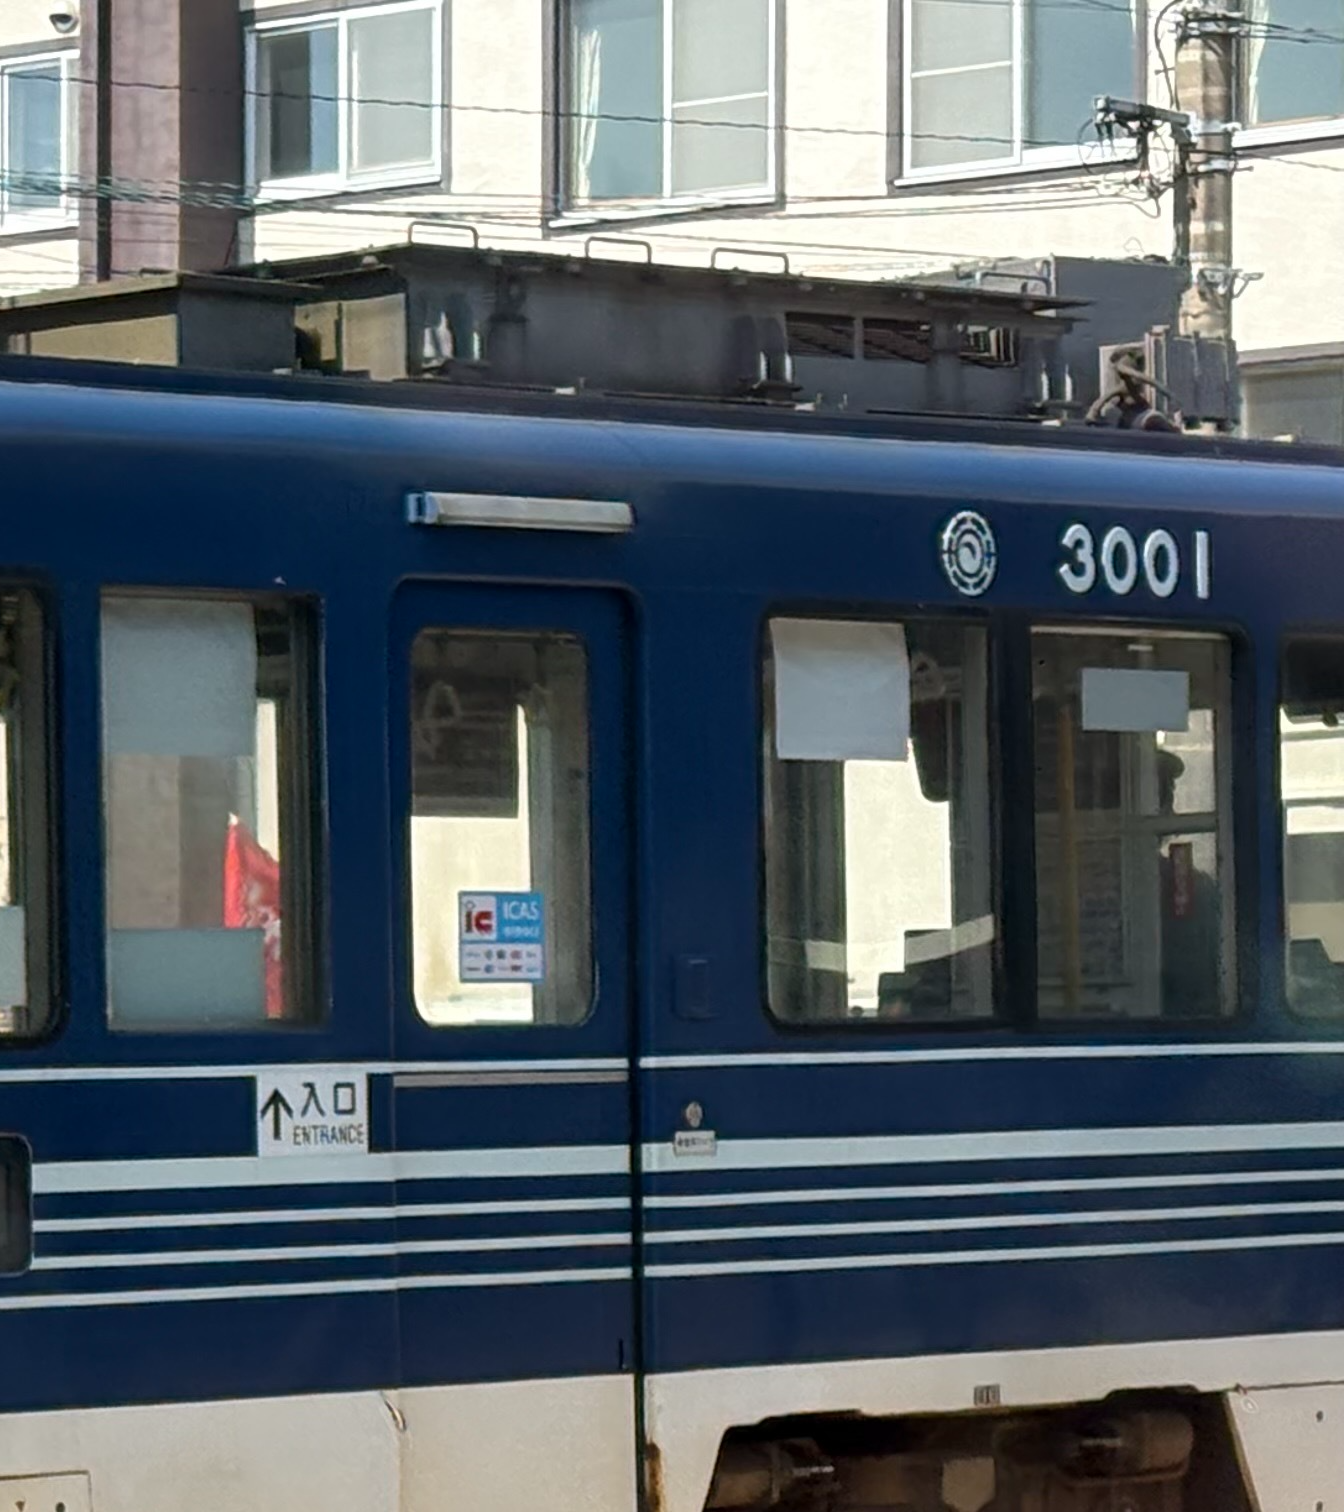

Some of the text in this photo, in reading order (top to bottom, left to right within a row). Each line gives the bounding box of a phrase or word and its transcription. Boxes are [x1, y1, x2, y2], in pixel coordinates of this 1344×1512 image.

[1058, 523, 1209, 600] 3001
[301, 1082, 357, 1118] 入口
[293, 1124, 365, 1146] ENTRANCE
